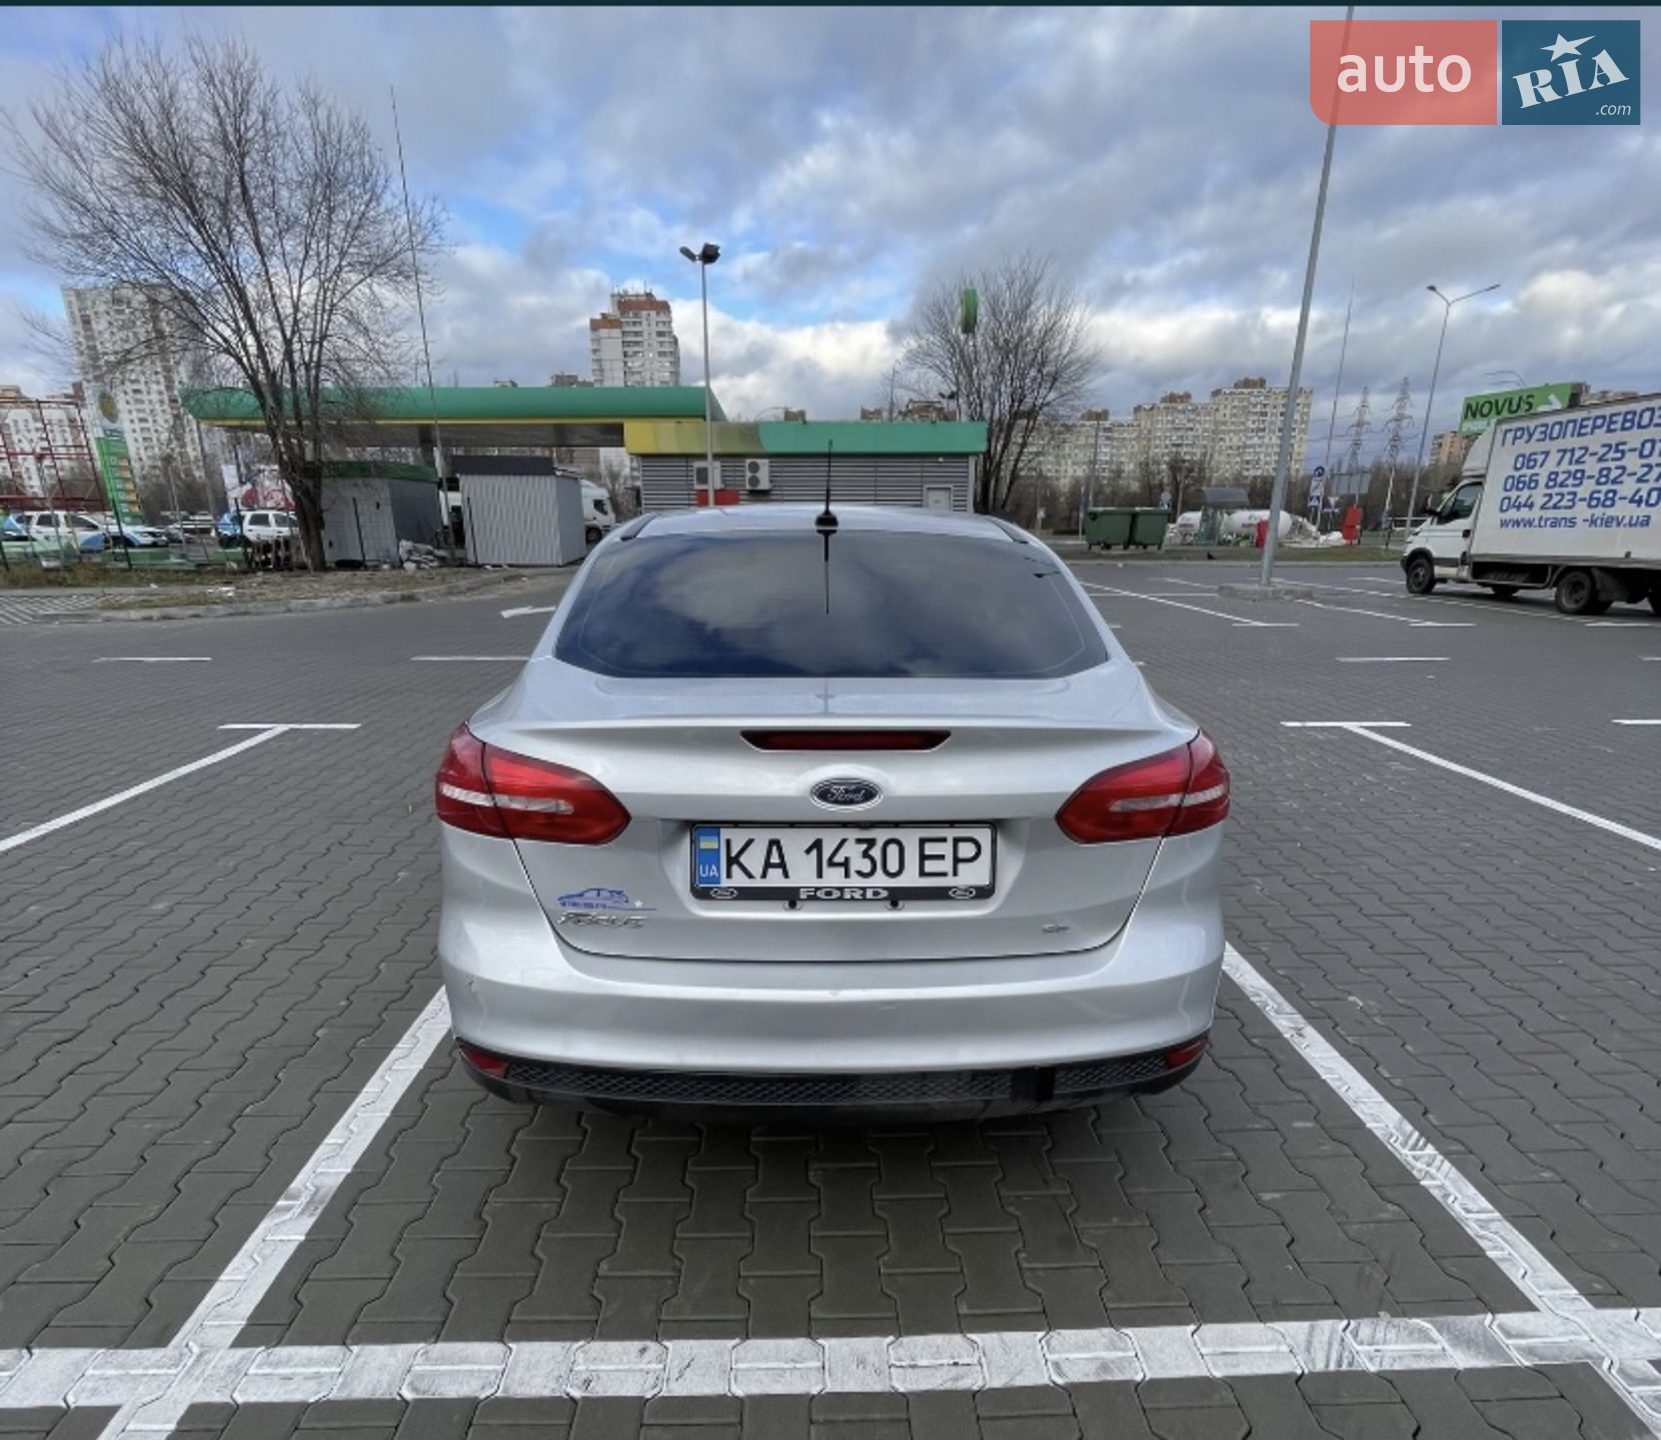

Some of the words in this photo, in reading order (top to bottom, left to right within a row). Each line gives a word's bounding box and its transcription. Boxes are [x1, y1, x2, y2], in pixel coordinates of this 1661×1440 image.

[1463, 395, 1535, 420] NOVUS
[1513, 450, 1550, 471] 067
[1503, 473, 1540, 492] 066
[1499, 495, 1535, 513] 044
[1540, 486, 1661, 511] 223-68-40
[1499, 514, 1578, 529] www.trans
[1582, 512, 1652, 528] -kiev.ua
[700, 864, 719, 878] UA
[725, 838, 791, 879] KA
[804, 837, 906, 879] 1430
[918, 836, 982, 878] EP
[800, 888, 889, 899] FORD
